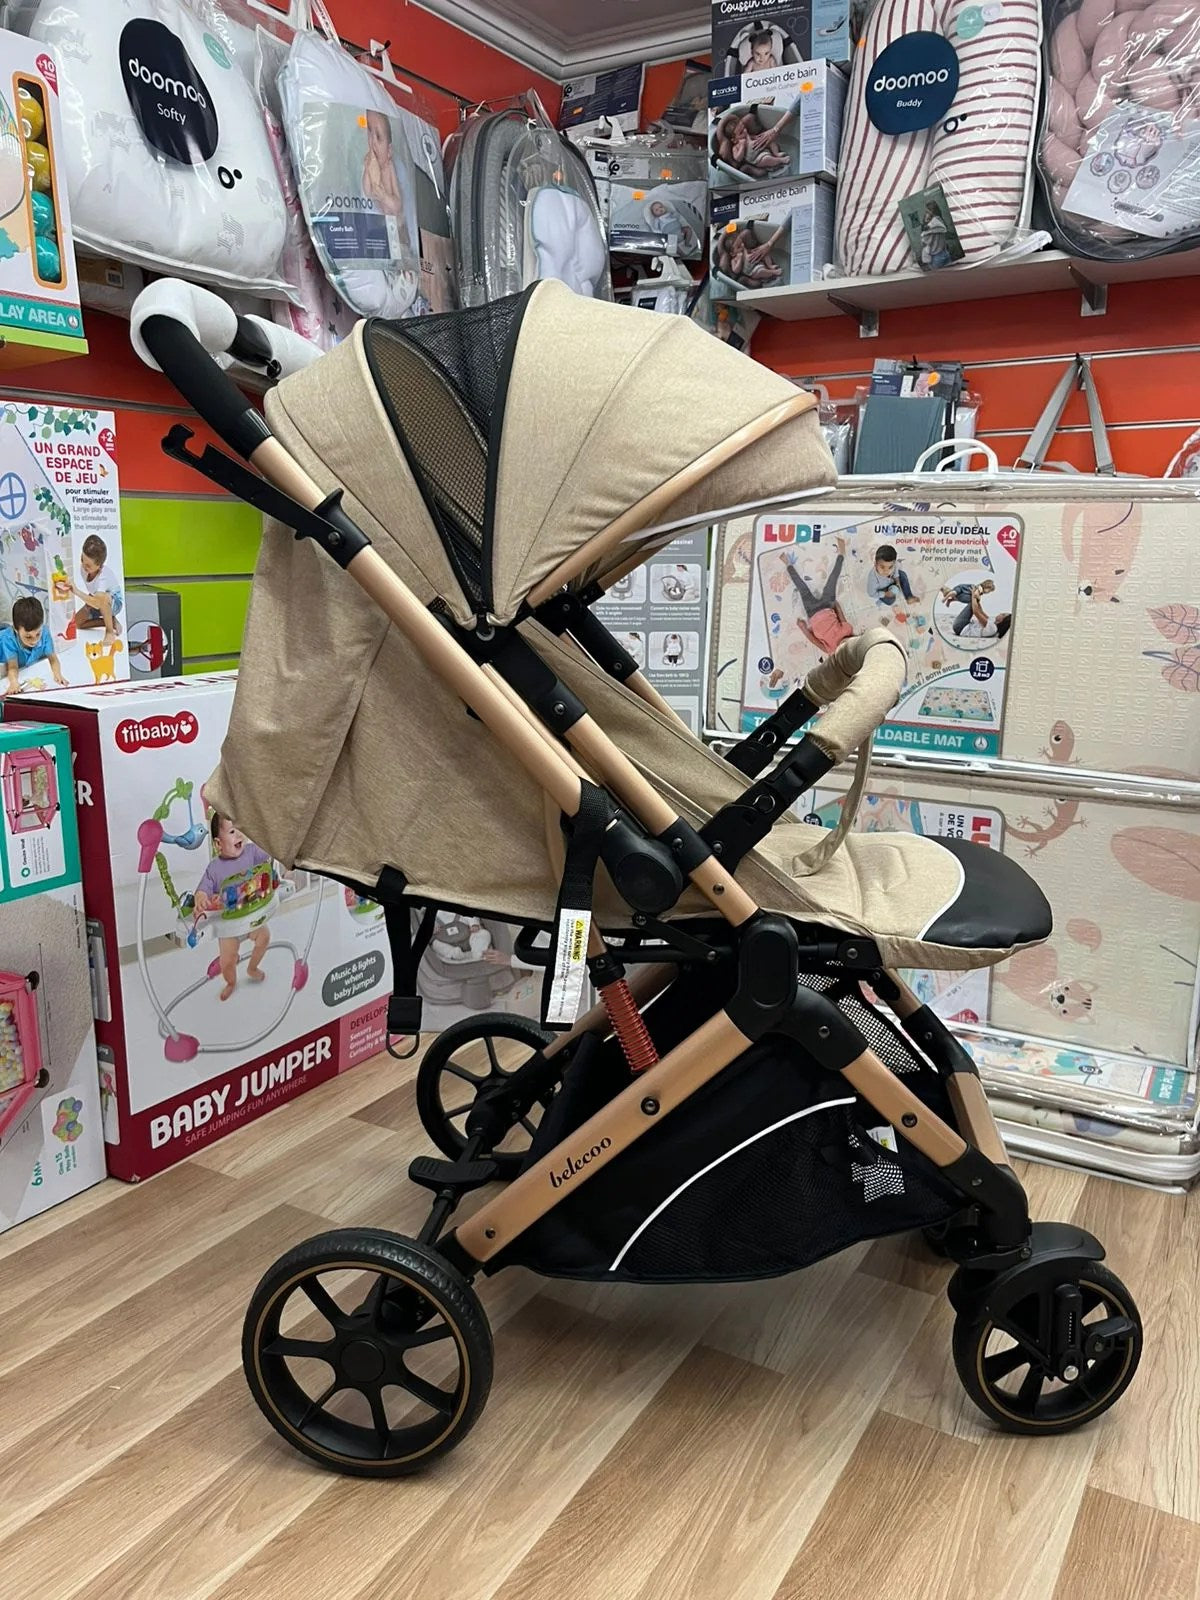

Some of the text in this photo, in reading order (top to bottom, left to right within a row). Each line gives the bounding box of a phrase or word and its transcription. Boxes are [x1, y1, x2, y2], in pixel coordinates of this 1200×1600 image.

[128, 58, 206, 109] doomoo
[745, 67, 817, 89] Coussin de bain
[873, 68, 949, 92] doomoo
[896, 99, 923, 108] Buddy
[157, 103, 187, 126] Softy
[743, 192, 775, 206] Coussin
[776, 188, 788, 199] de
[789, 185, 807, 197] bain
[28, 307, 66, 328] AREA
[100, 432, 114, 443] +2
[34, 441, 53, 454] UN
[57, 443, 101, 457] GRAND
[46, 457, 94, 471] ESPACE
[55, 472, 98, 485] DE JEU
[65, 488, 110, 496] pour stimuler
[72, 496, 114, 505] l'imagination
[874, 524, 991, 536] UN TAPIS DE JEU IDÉAL
[1001, 529, 1018, 540] +0
[954, 538, 989, 546] motricité
[934, 555, 956, 563] motor
[959, 555, 979, 563] skills
[948, 547, 965, 556] play
[925, 671, 941, 681] BOTH
[942, 663, 961, 674] SIDES
[121, 721, 179, 744] tiibaby
[934, 734, 965, 748] MAT
[947, 813, 956, 826] DE
[957, 814, 965, 828] UN
[572, 929, 582, 960] WARNING
[330, 955, 377, 983] Music & lights
[344, 972, 364, 986] when
[333, 974, 376, 1001] baby jumps!
[150, 1035, 332, 1150] BABY JUMPER
[184, 1075, 307, 1146] SAFE JUMPING FUN ANYWHERE
[549, 1137, 612, 1188] belecoo
